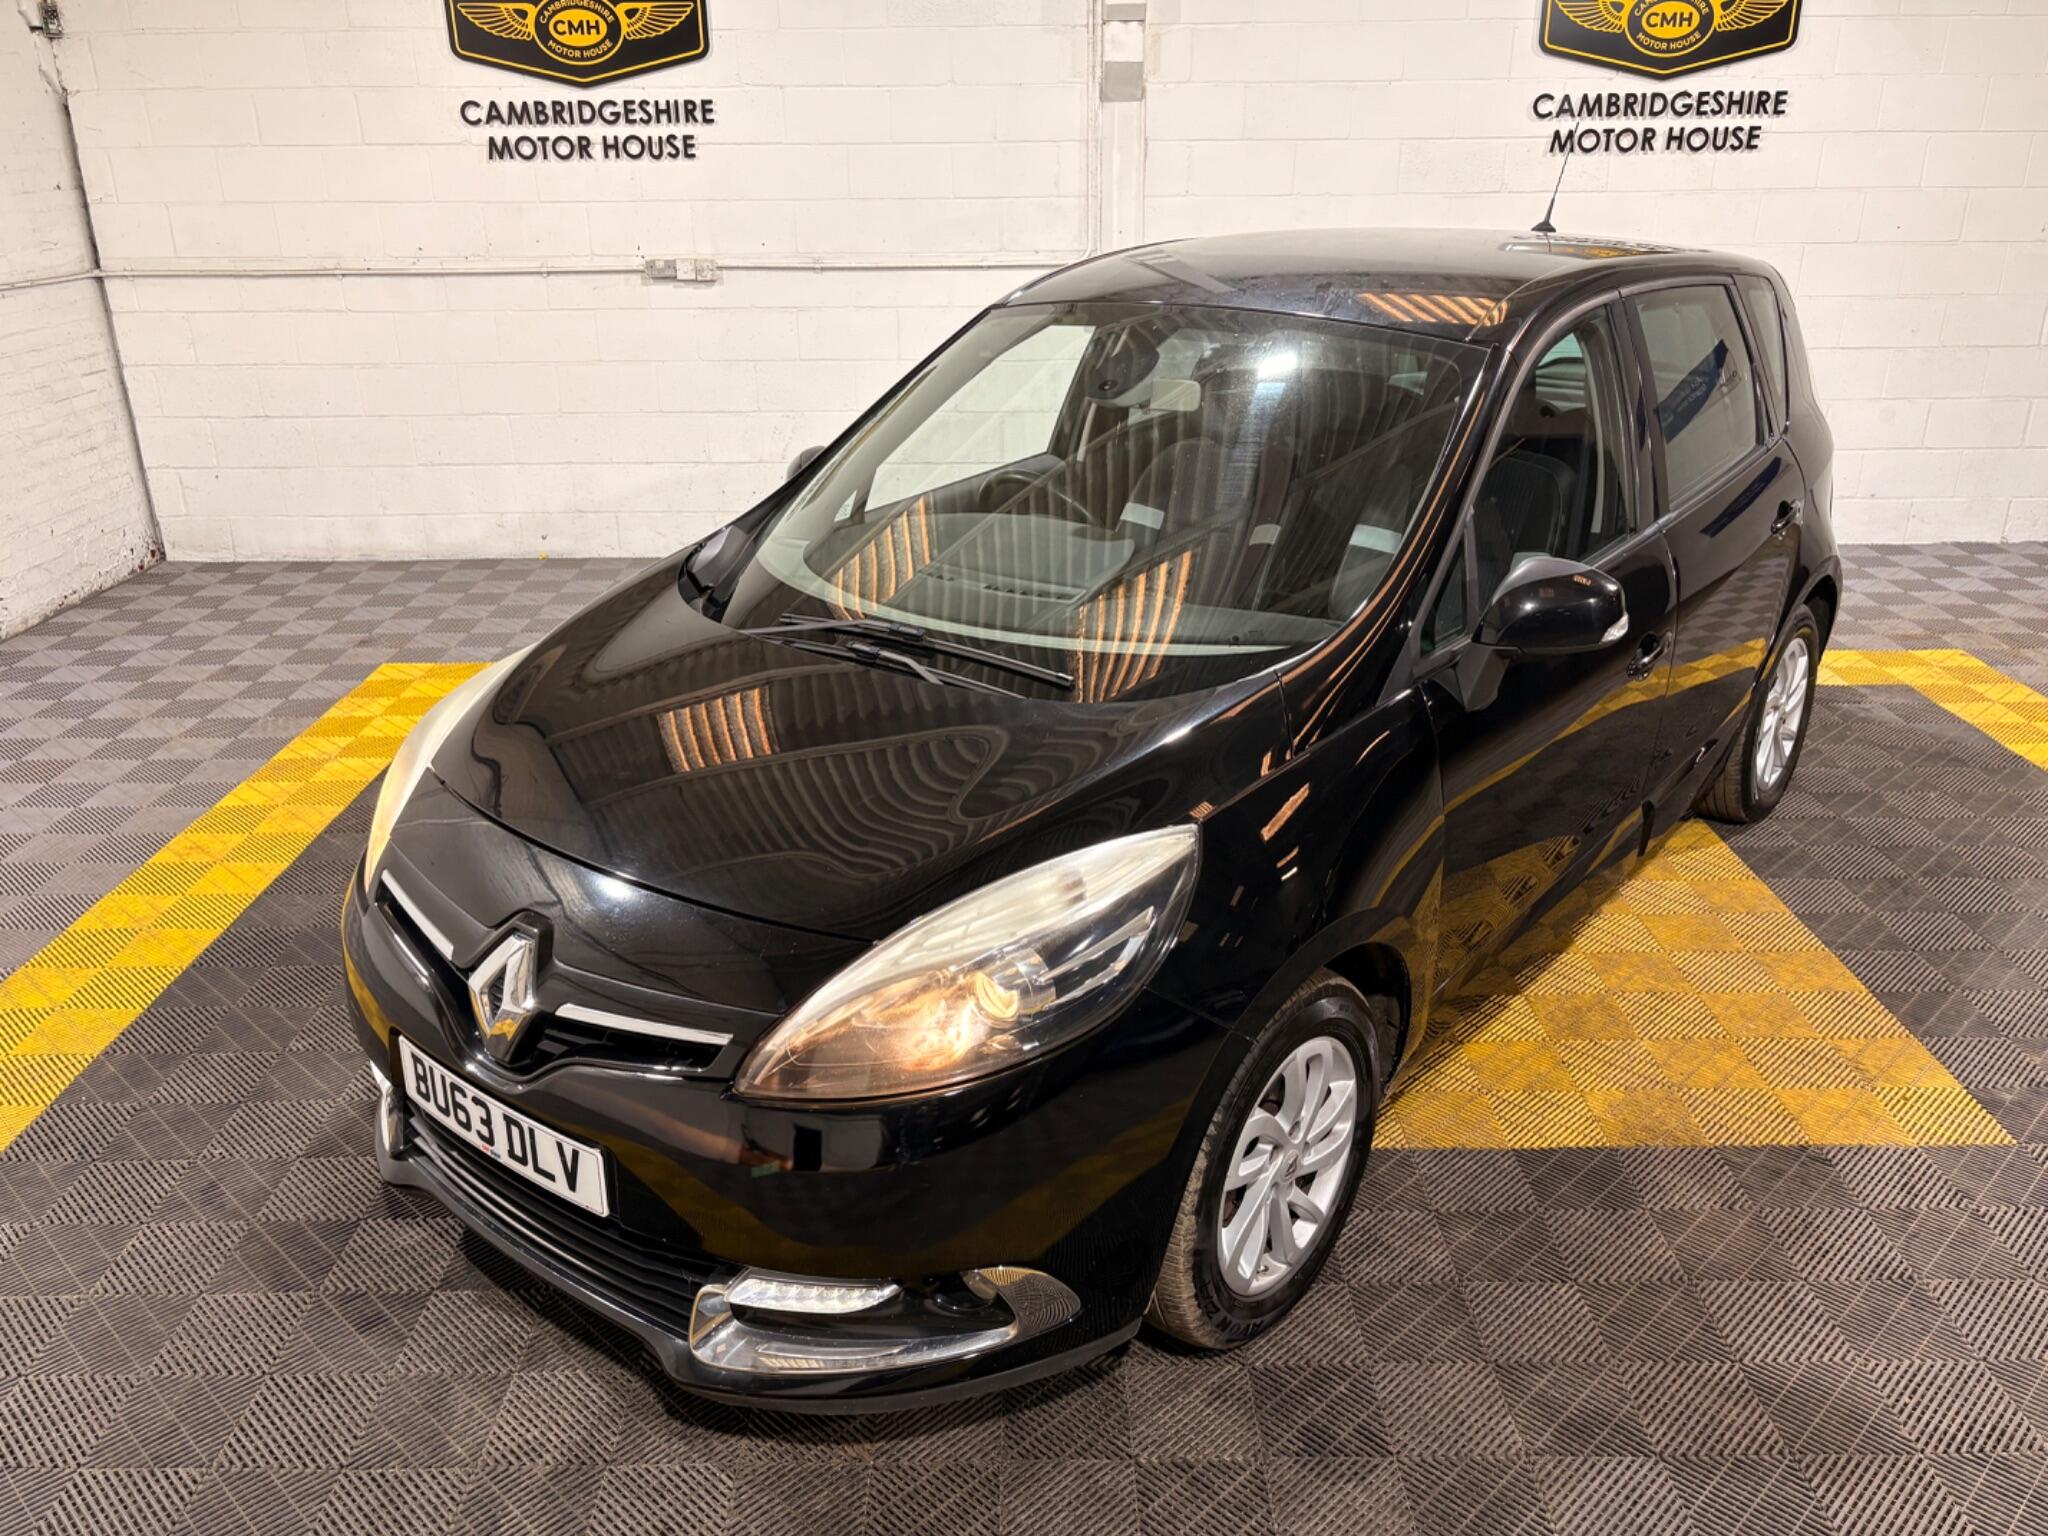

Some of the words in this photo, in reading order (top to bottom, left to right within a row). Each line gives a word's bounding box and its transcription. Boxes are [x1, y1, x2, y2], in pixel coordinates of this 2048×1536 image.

[553, 19, 601, 36] CMH
[1646, 12, 1693, 28] CMH
[547, 39, 582, 58] MOTOR
[583, 38, 613, 58] HOUSE
[1635, 32, 1668, 50] MOTOR
[1669, 31, 1702, 50] HOUSE
[460, 99, 715, 126] CAMBRIDGESHIRE
[1532, 90, 1789, 119] CAMBRIDGESHIRE
[488, 135, 593, 160] MOTOR
[602, 134, 697, 160] HOUSE
[1549, 127, 1657, 153] MOTOR
[1665, 126, 1762, 151] HOUSE
[411, 1052, 496, 1148] BU63
[503, 1113, 580, 1194] DLV
